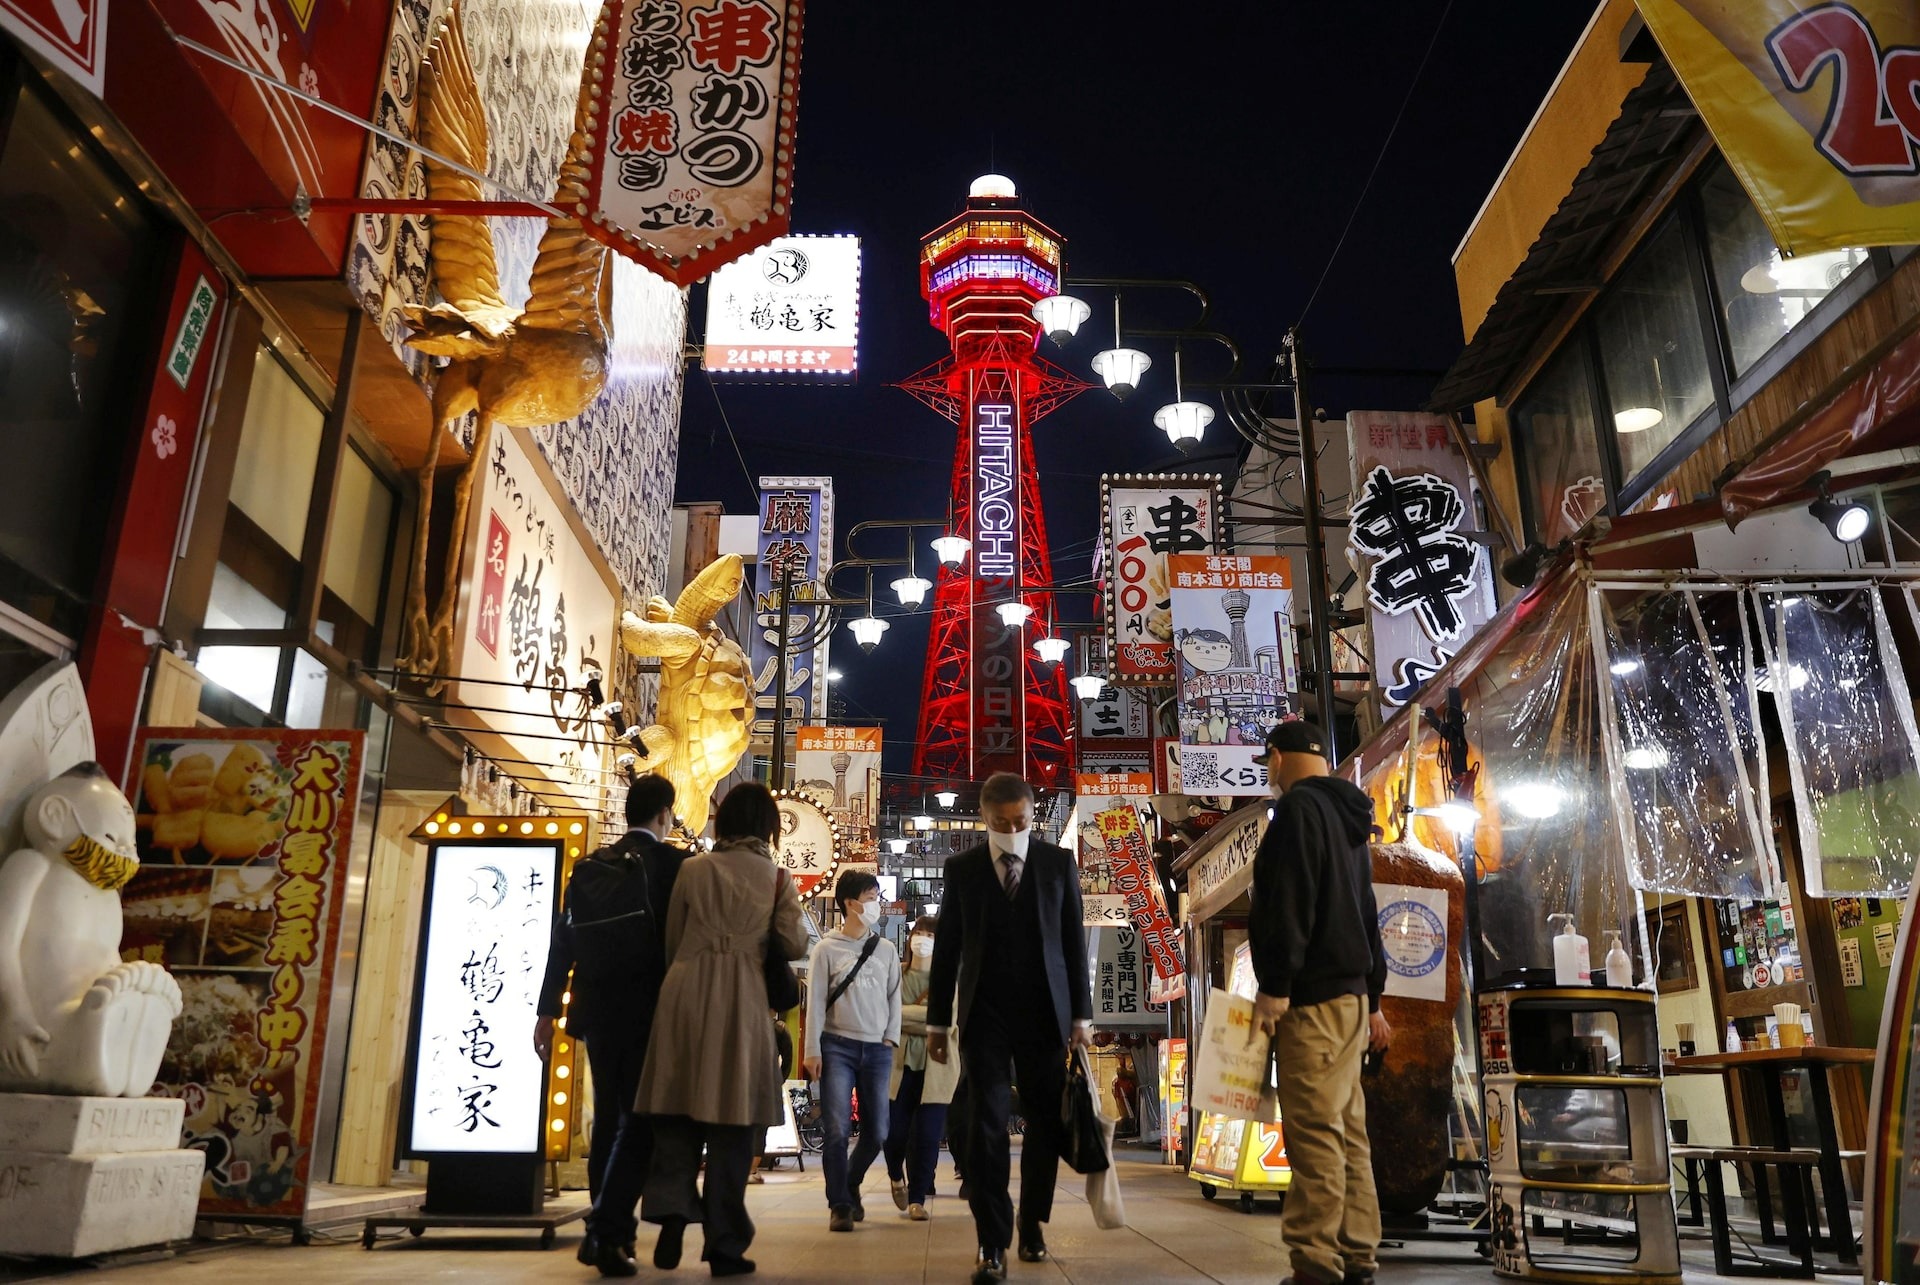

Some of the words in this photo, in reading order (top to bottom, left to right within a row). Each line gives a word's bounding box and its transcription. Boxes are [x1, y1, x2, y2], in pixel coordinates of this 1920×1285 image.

[611, 2, 684, 192] お好み焼き
[682, 0, 779, 188] 串かつ
[639, 203, 715, 231] エビス
[750, 302, 837, 332] 鶴亀家
[727, 349, 831, 365] 24時間営業中
[1369, 423, 1450, 450] 新世界
[979, 404, 1013, 576] HITACHI
[1121, 508, 1136, 533] 全て
[1144, 495, 1209, 555] 串
[760, 490, 812, 583] 麻雀
[1206, 556, 1252, 571] 通天閣
[1350, 466, 1480, 643] 串
[1177, 572, 1284, 588] 南本通り商店会
[802, 740, 876, 751] 南本通り商店会
[824, 728, 856, 739] 通天閣
[1081, 784, 1148, 795] 南本通り商店会
[1100, 773, 1129, 784] 通天閣
[1117, 926, 1137, 1013] ツ専門店
[1101, 961, 1114, 1013] 通天閣店
[454, 942, 505, 1133] 鶴亀家
